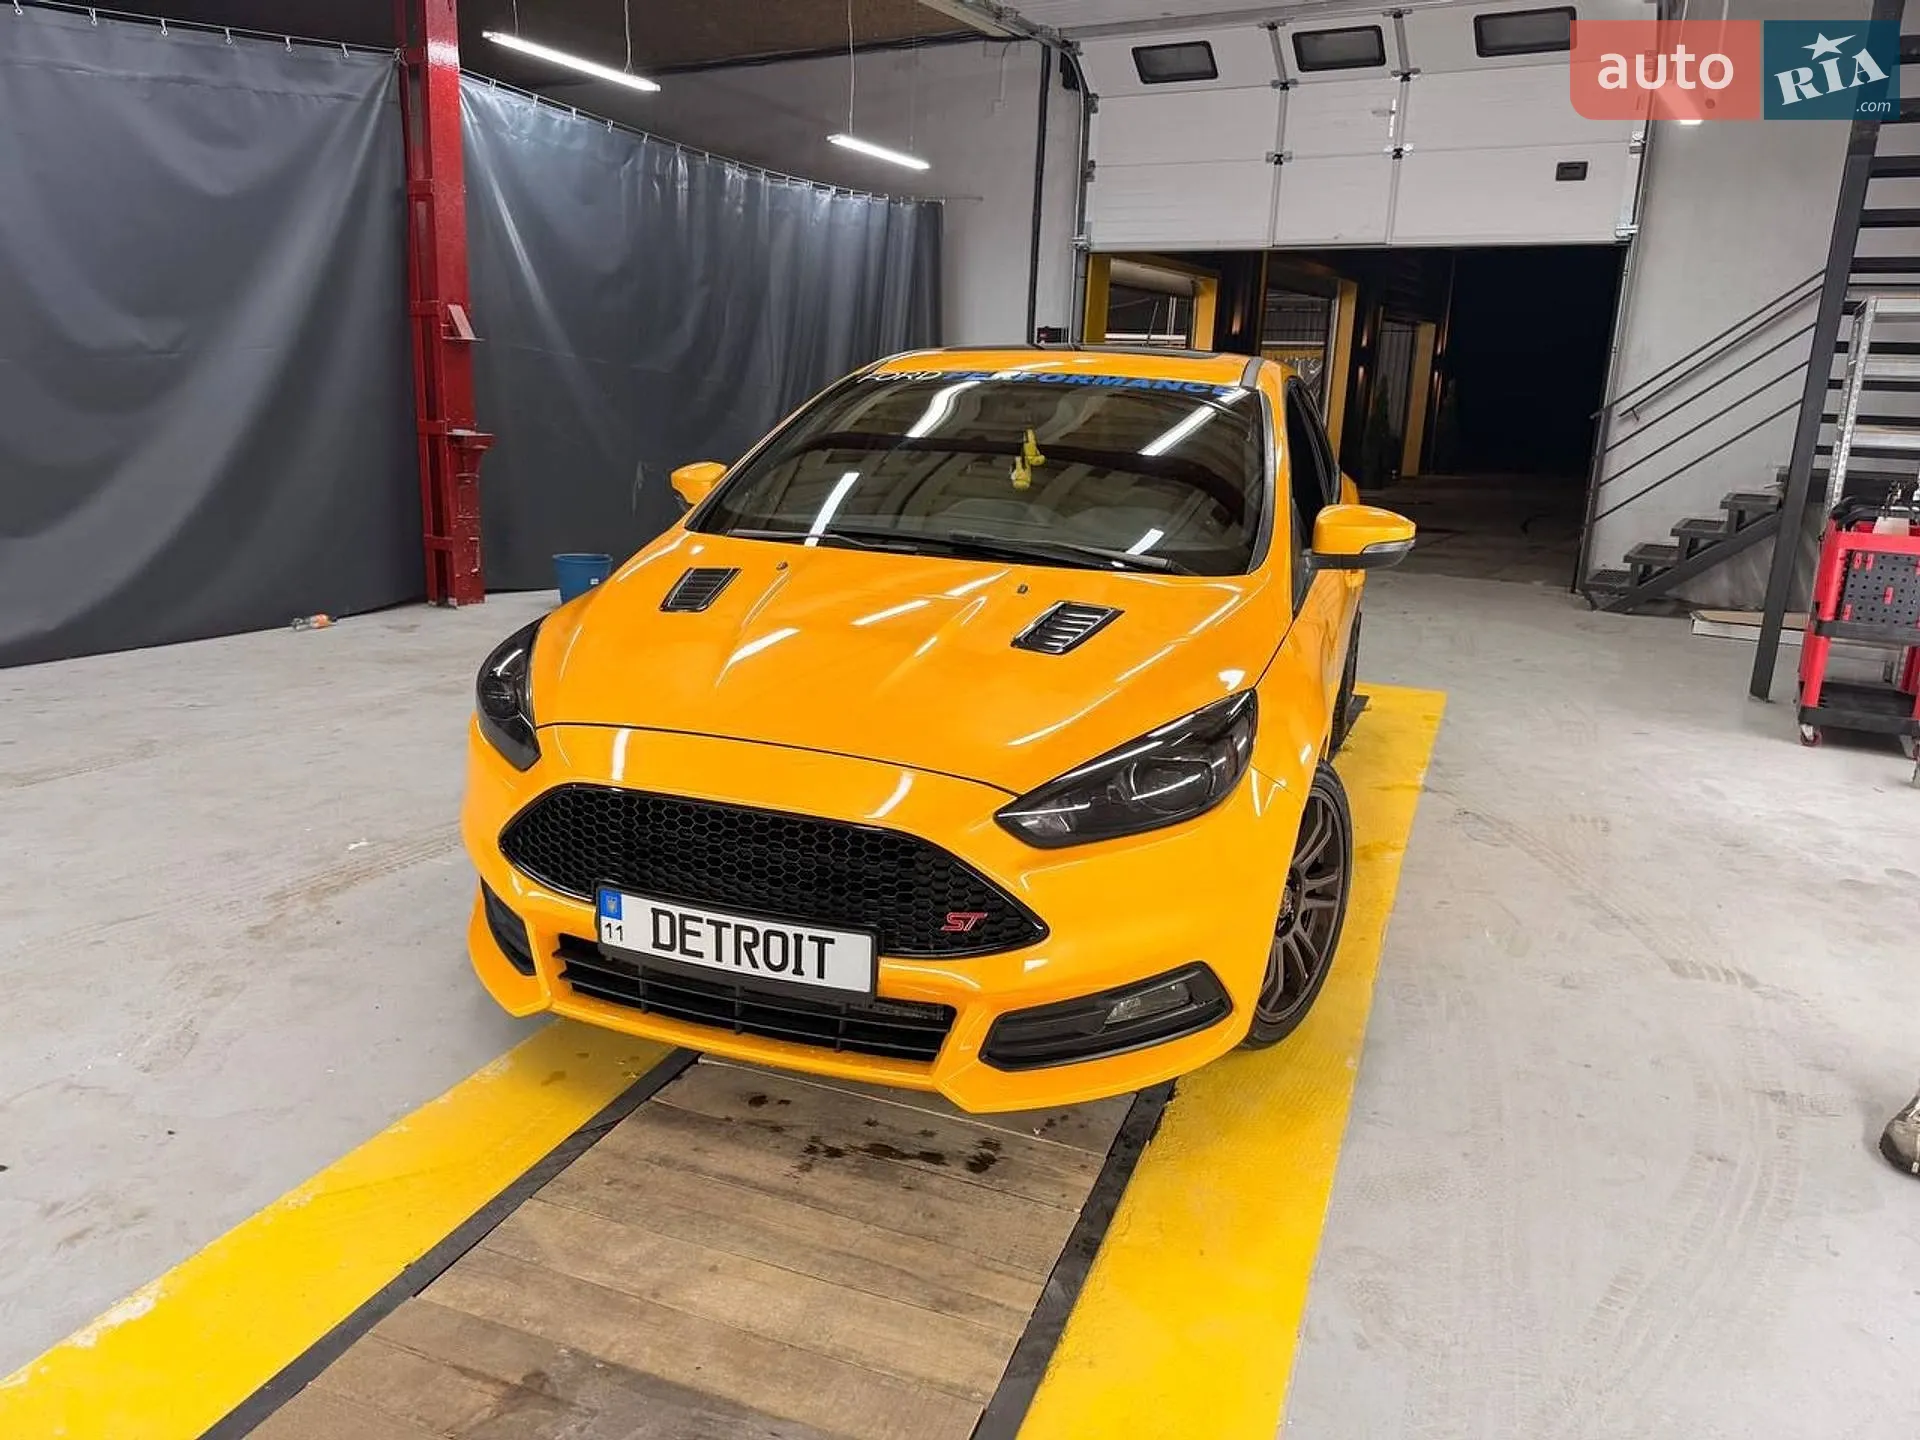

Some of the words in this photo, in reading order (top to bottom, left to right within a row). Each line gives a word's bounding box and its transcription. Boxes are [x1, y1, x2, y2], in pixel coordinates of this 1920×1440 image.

[604, 922, 624, 942] 11
[651, 907, 836, 979] DETROIT
[940, 911, 988, 932] ST
